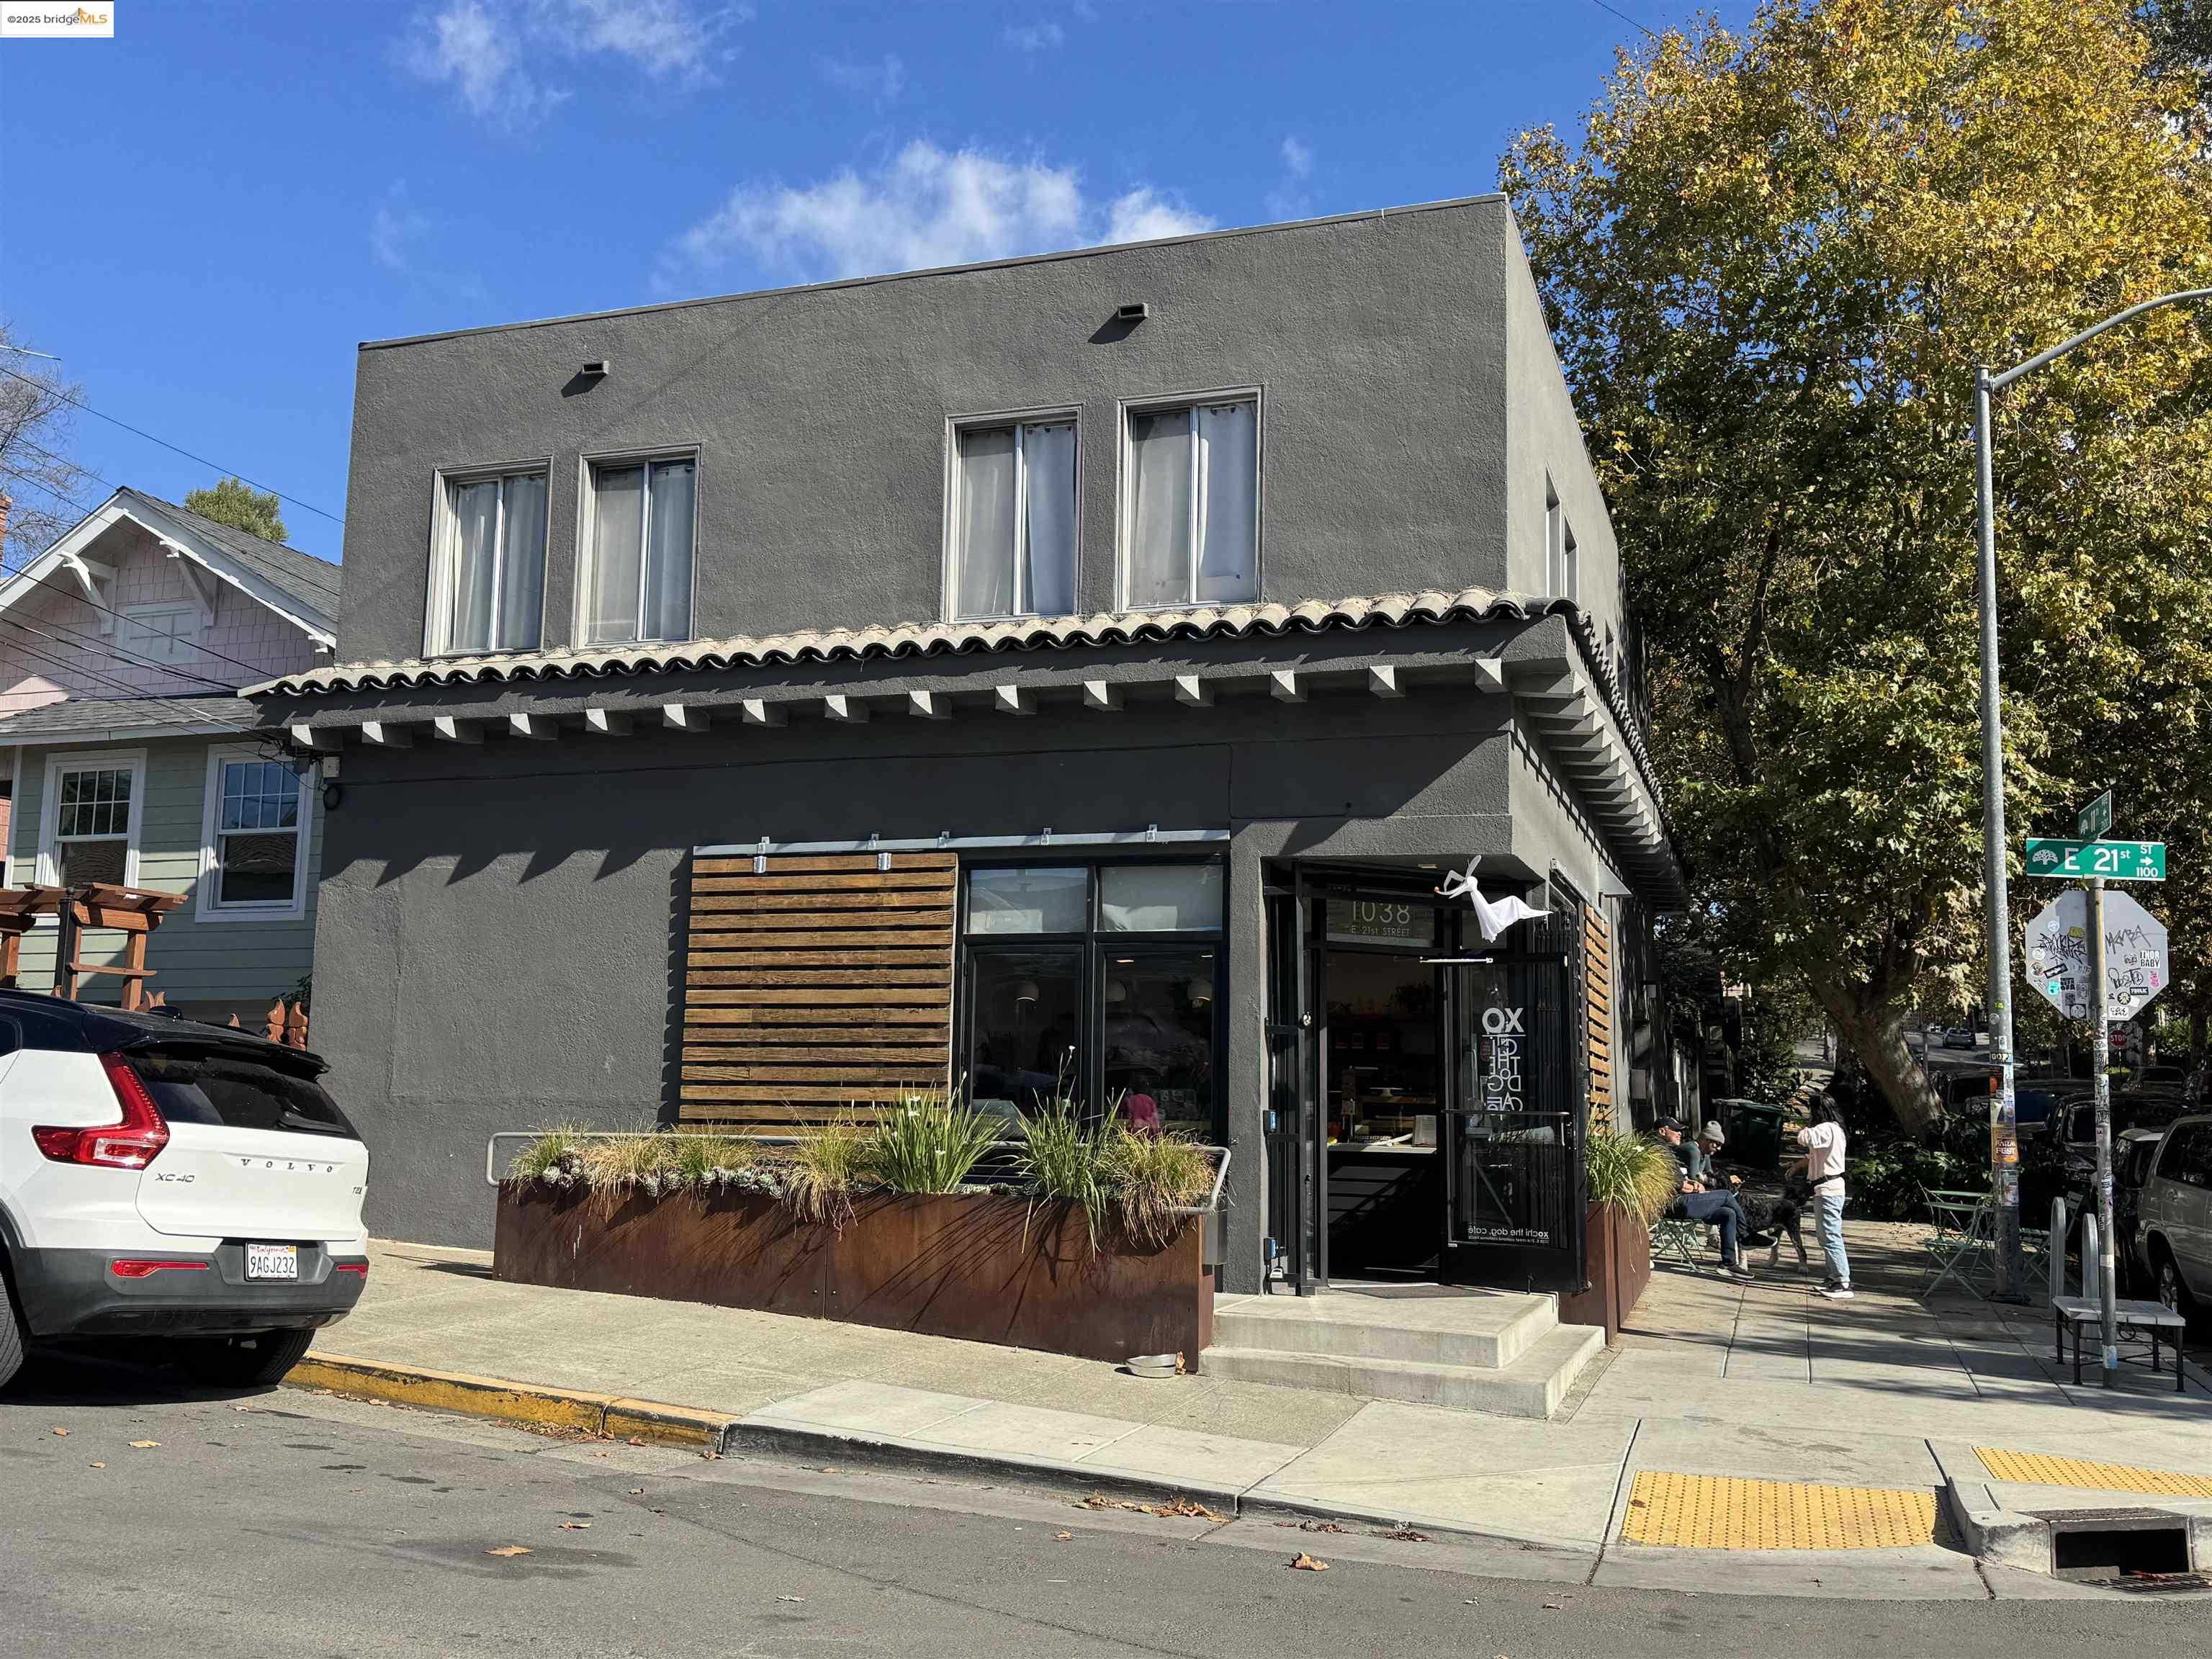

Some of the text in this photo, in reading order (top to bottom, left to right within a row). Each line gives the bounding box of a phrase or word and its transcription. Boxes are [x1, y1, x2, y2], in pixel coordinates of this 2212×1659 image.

[2140, 845, 2153, 855] ST
[2064, 848, 2131, 872] E 21st
[2136, 867, 2159, 878] 1100
[1353, 900, 1411, 925] 1038
[1382, 927, 1411, 938] STREET
[2141, 958, 2159, 968] BABY
[241, 1158, 333, 1173] VOLVO
[251, 1256, 295, 1274] 9AGJ232
